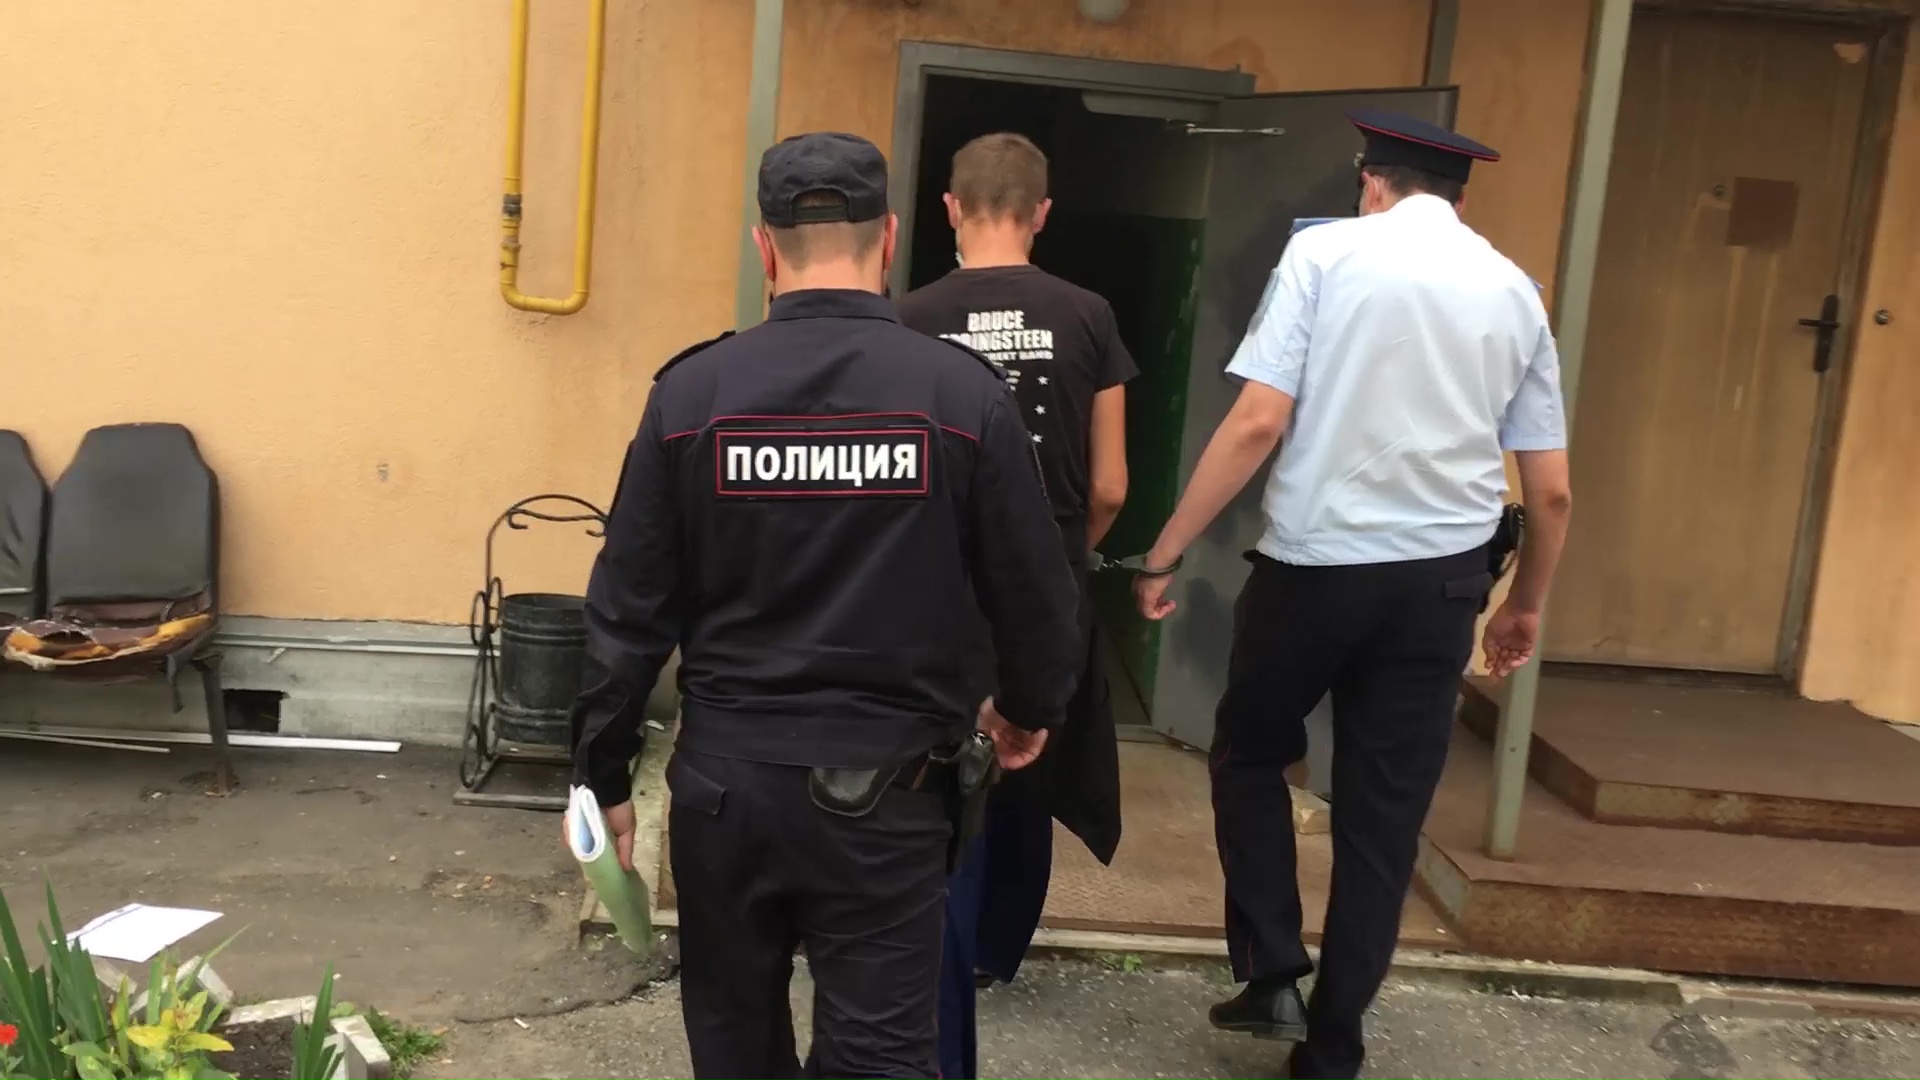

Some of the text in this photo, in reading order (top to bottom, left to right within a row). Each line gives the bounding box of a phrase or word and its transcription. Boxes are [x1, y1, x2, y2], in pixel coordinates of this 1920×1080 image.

[967, 310, 1025, 332] BRUCE
[938, 329, 1053, 351] RINGSTEEN
[1019, 350, 1053, 361] BAND
[727, 444, 917, 487] ПОЛИЦИЯ
